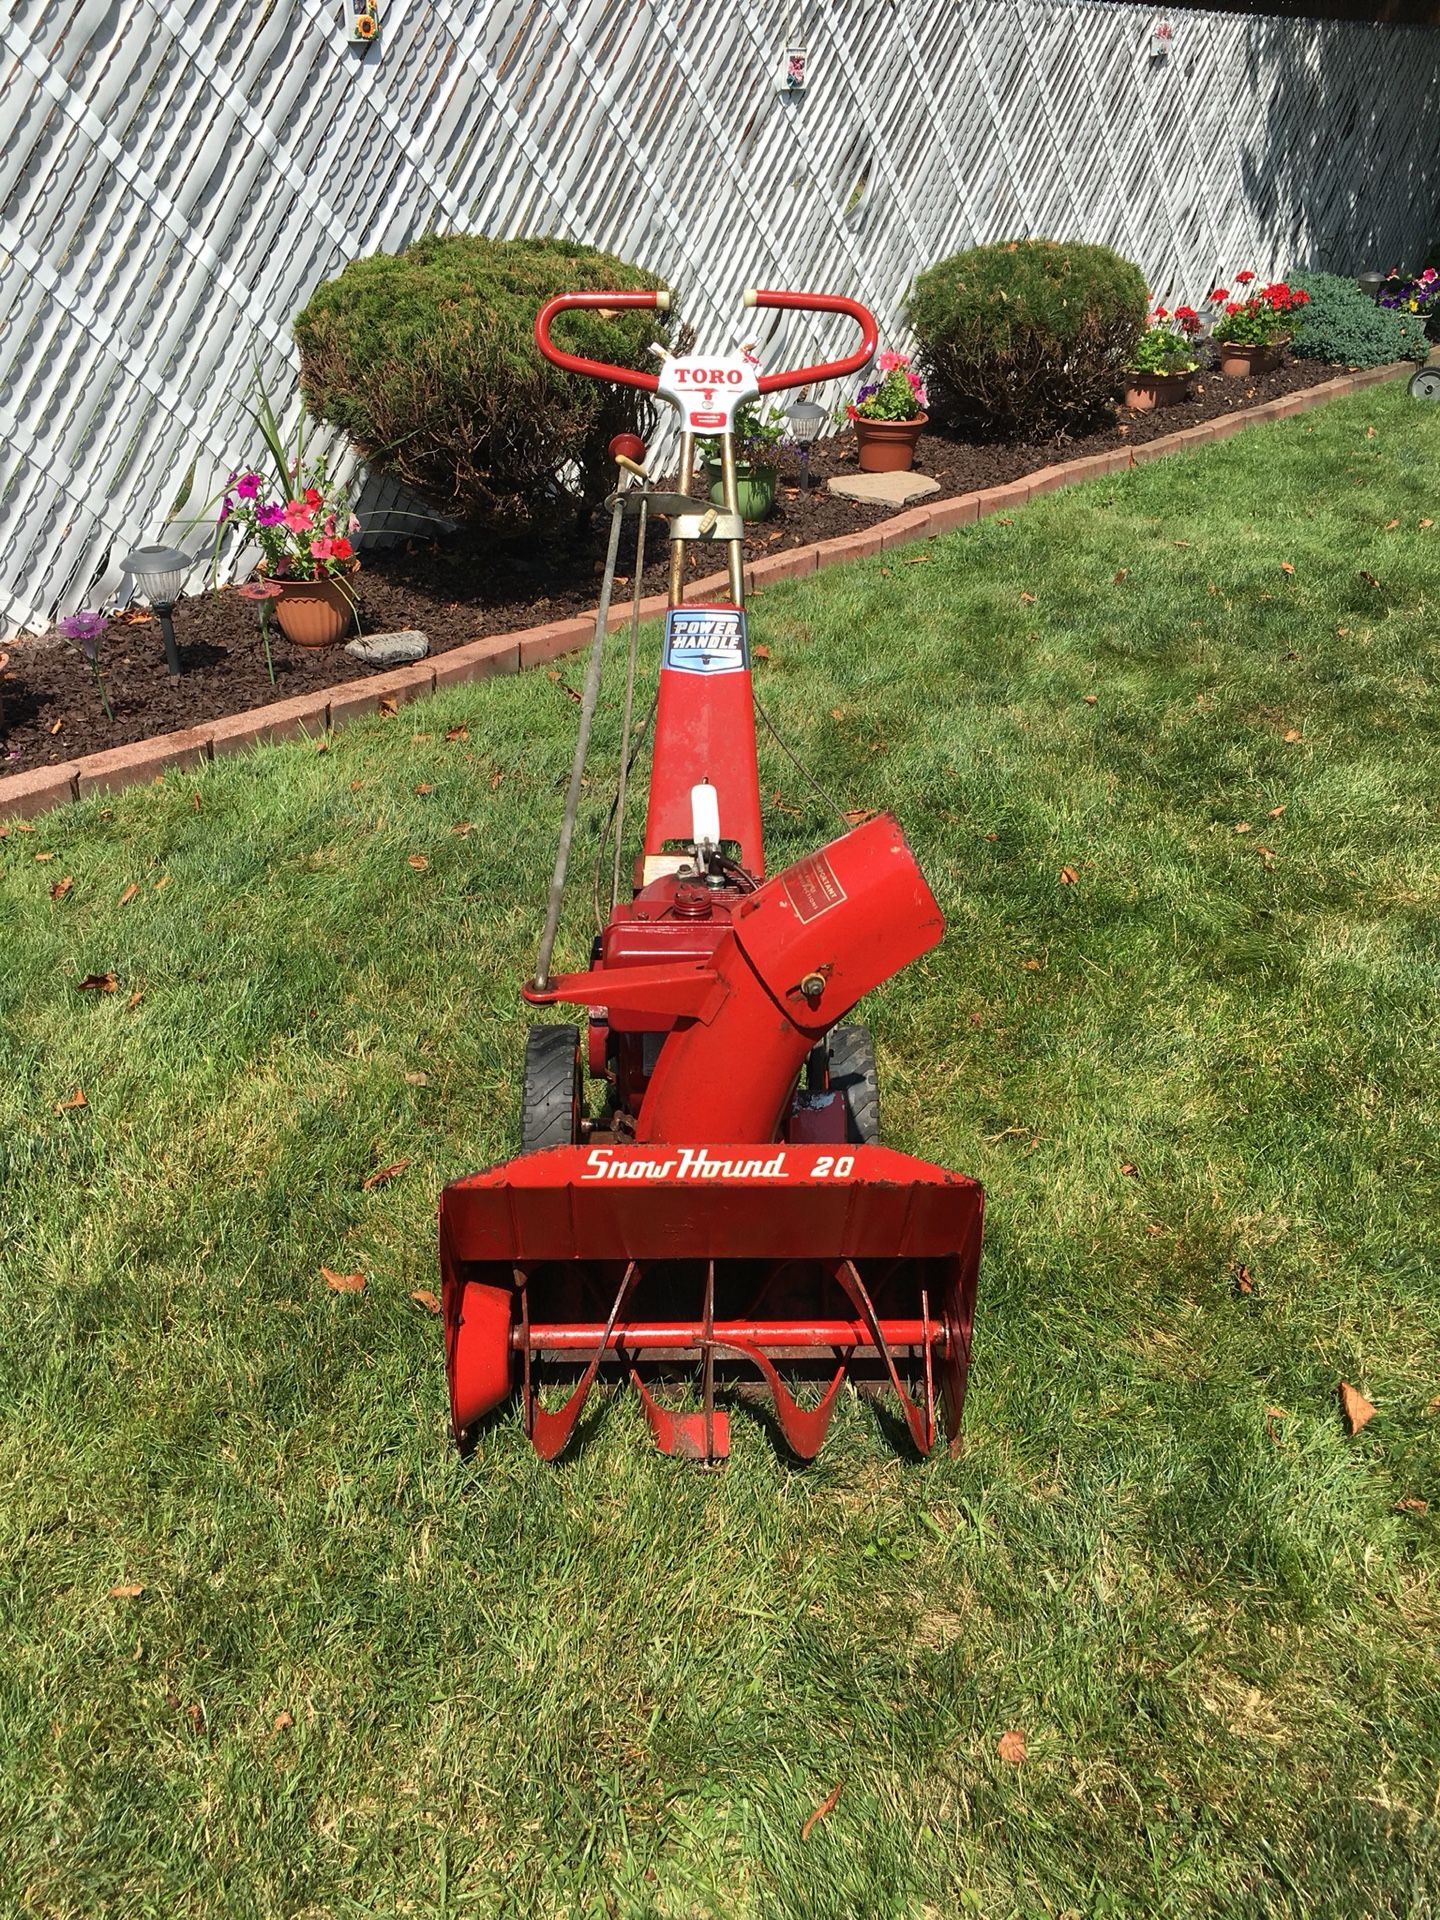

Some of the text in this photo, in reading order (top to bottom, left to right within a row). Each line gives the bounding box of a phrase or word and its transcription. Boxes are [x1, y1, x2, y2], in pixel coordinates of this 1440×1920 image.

[674, 368, 743, 384] TORO
[673, 621, 738, 635] POWER
[672, 635, 740, 649] HANDLE
[816, 863, 837, 898] PORTANT
[810, 1156, 855, 1178] 20
